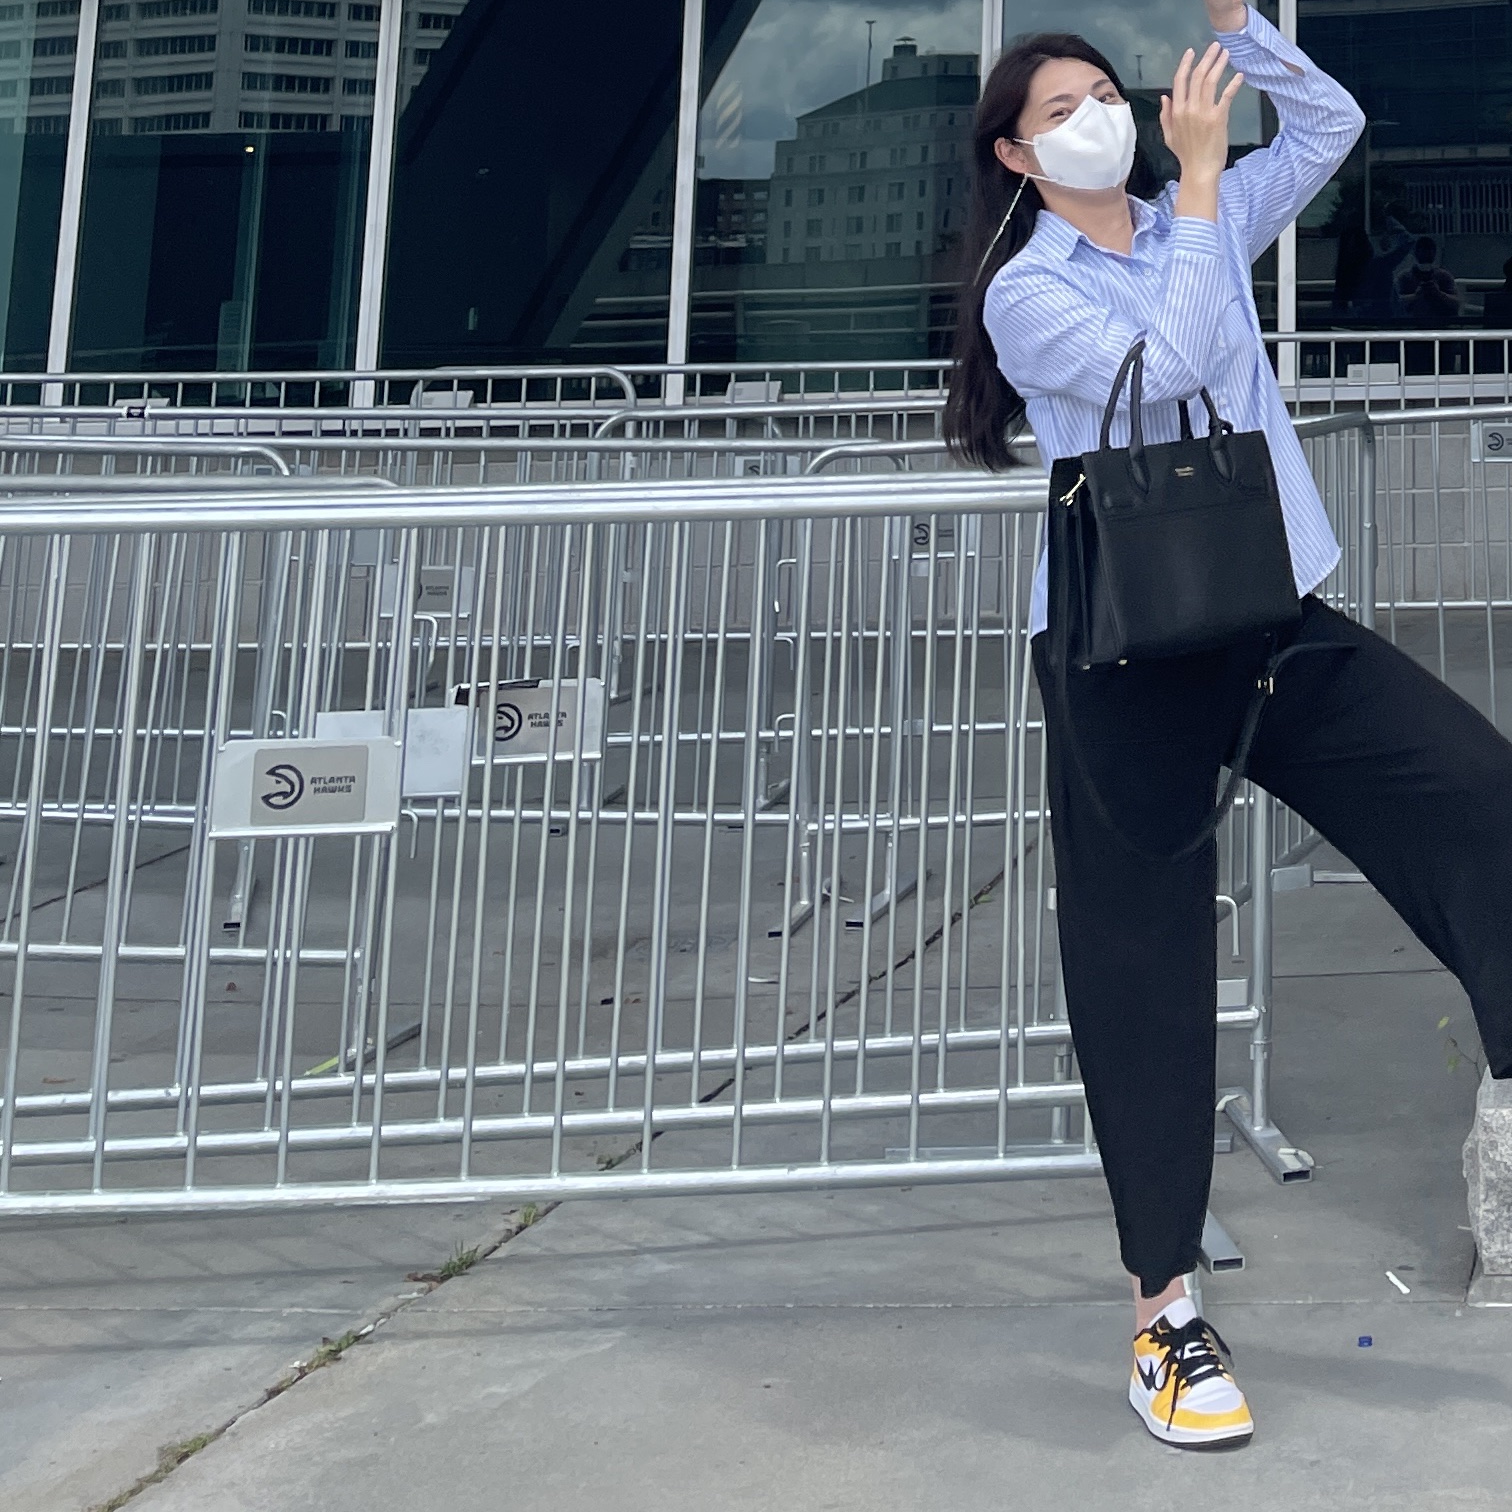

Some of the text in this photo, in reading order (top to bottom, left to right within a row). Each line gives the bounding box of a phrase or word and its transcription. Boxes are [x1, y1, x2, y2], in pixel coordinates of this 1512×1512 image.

[527, 711, 567, 720] ATLATA
[530, 719, 564, 728] HAWS
[310, 775, 356, 785] ATLANTA
[313, 784, 352, 794] HAWKS
